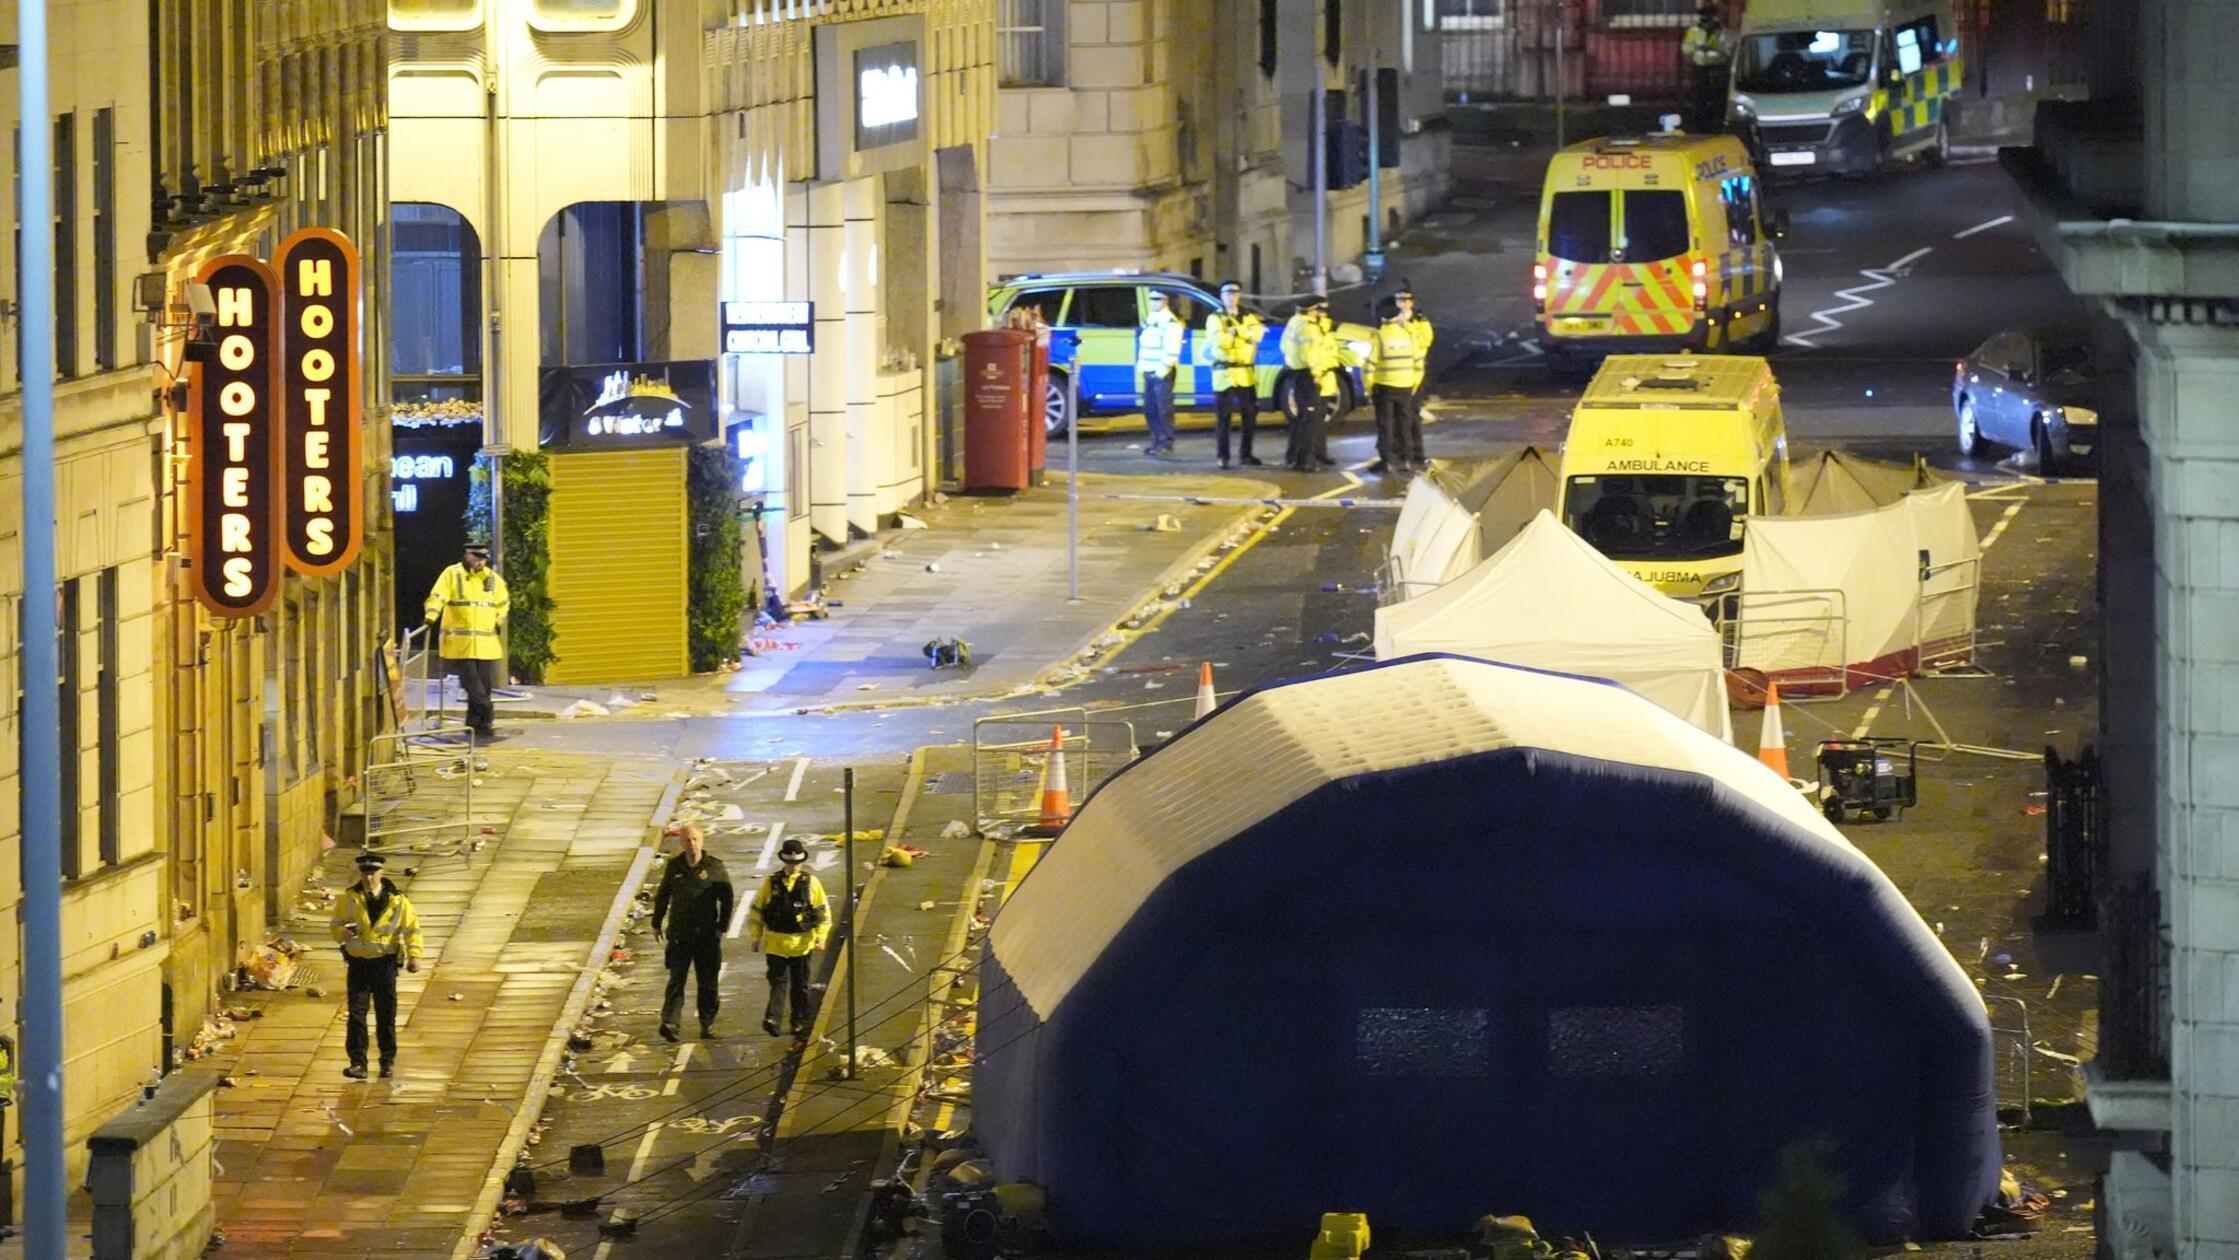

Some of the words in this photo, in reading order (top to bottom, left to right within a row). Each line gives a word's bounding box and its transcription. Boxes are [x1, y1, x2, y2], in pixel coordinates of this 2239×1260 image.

[1583, 156, 1652, 169] POLICE
[299, 259, 336, 556] HOOTERS
[218, 287, 256, 598] HOOTERS
[1605, 438, 1633, 447] A740
[1606, 460, 1710, 472] AMBULANCE
